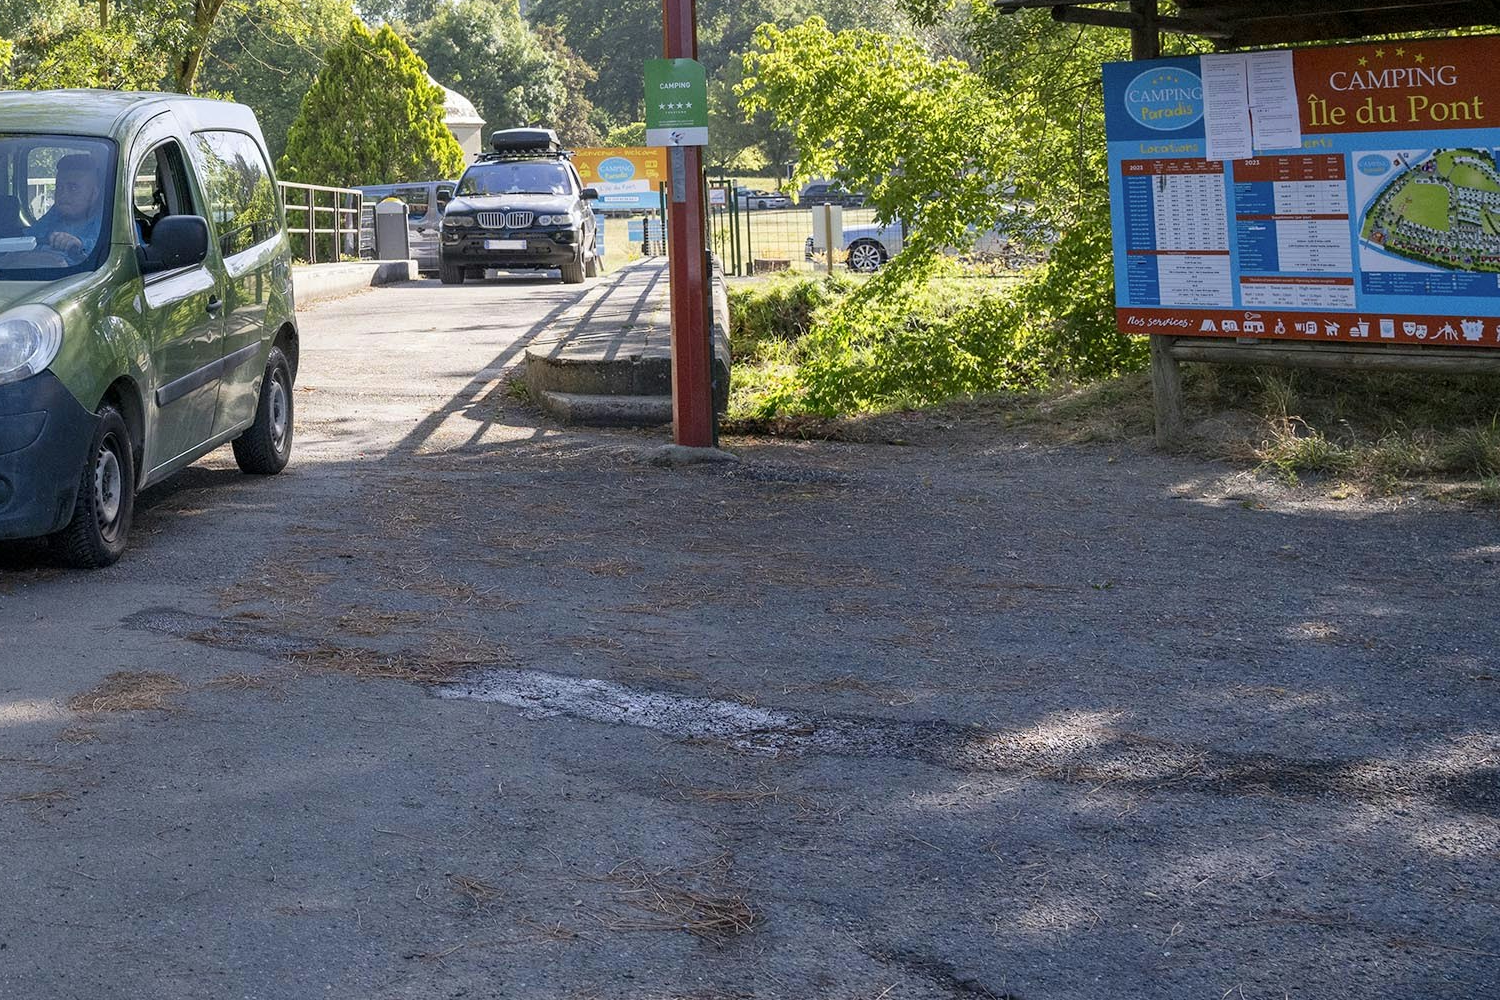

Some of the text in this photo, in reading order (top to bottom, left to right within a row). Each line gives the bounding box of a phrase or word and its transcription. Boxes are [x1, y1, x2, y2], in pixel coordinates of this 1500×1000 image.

[660, 81, 691, 89] CAMPING
[1329, 65, 1458, 92] CAMPING
[1129, 87, 1204, 103] CAMPING
[1141, 102, 1193, 121] Paradis
[1307, 93, 1485, 127] Île du Pont
[1140, 142, 1199, 154] Locations
[1127, 315, 1145, 327] Nos
